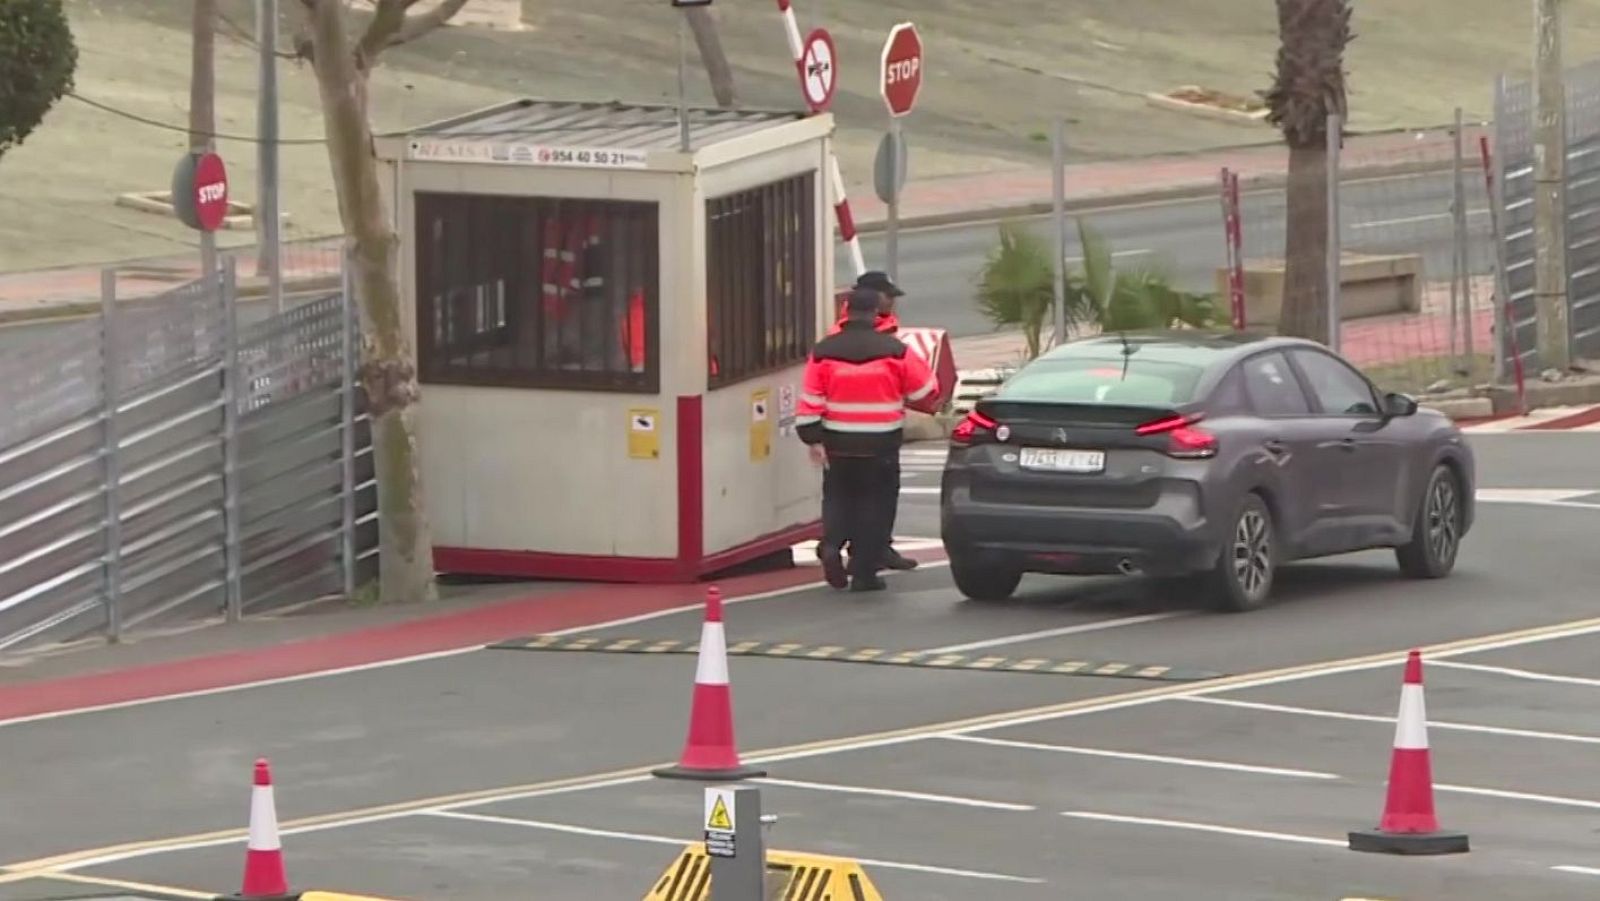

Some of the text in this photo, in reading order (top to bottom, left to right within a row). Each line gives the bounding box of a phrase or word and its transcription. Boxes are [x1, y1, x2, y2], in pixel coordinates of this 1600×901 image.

[887, 56, 919, 84] STOP
[552, 150, 573, 162] 954
[577, 150, 591, 163] 40
[594, 151, 609, 164] 50
[611, 152, 624, 165] 21
[199, 182, 225, 204] STOP
